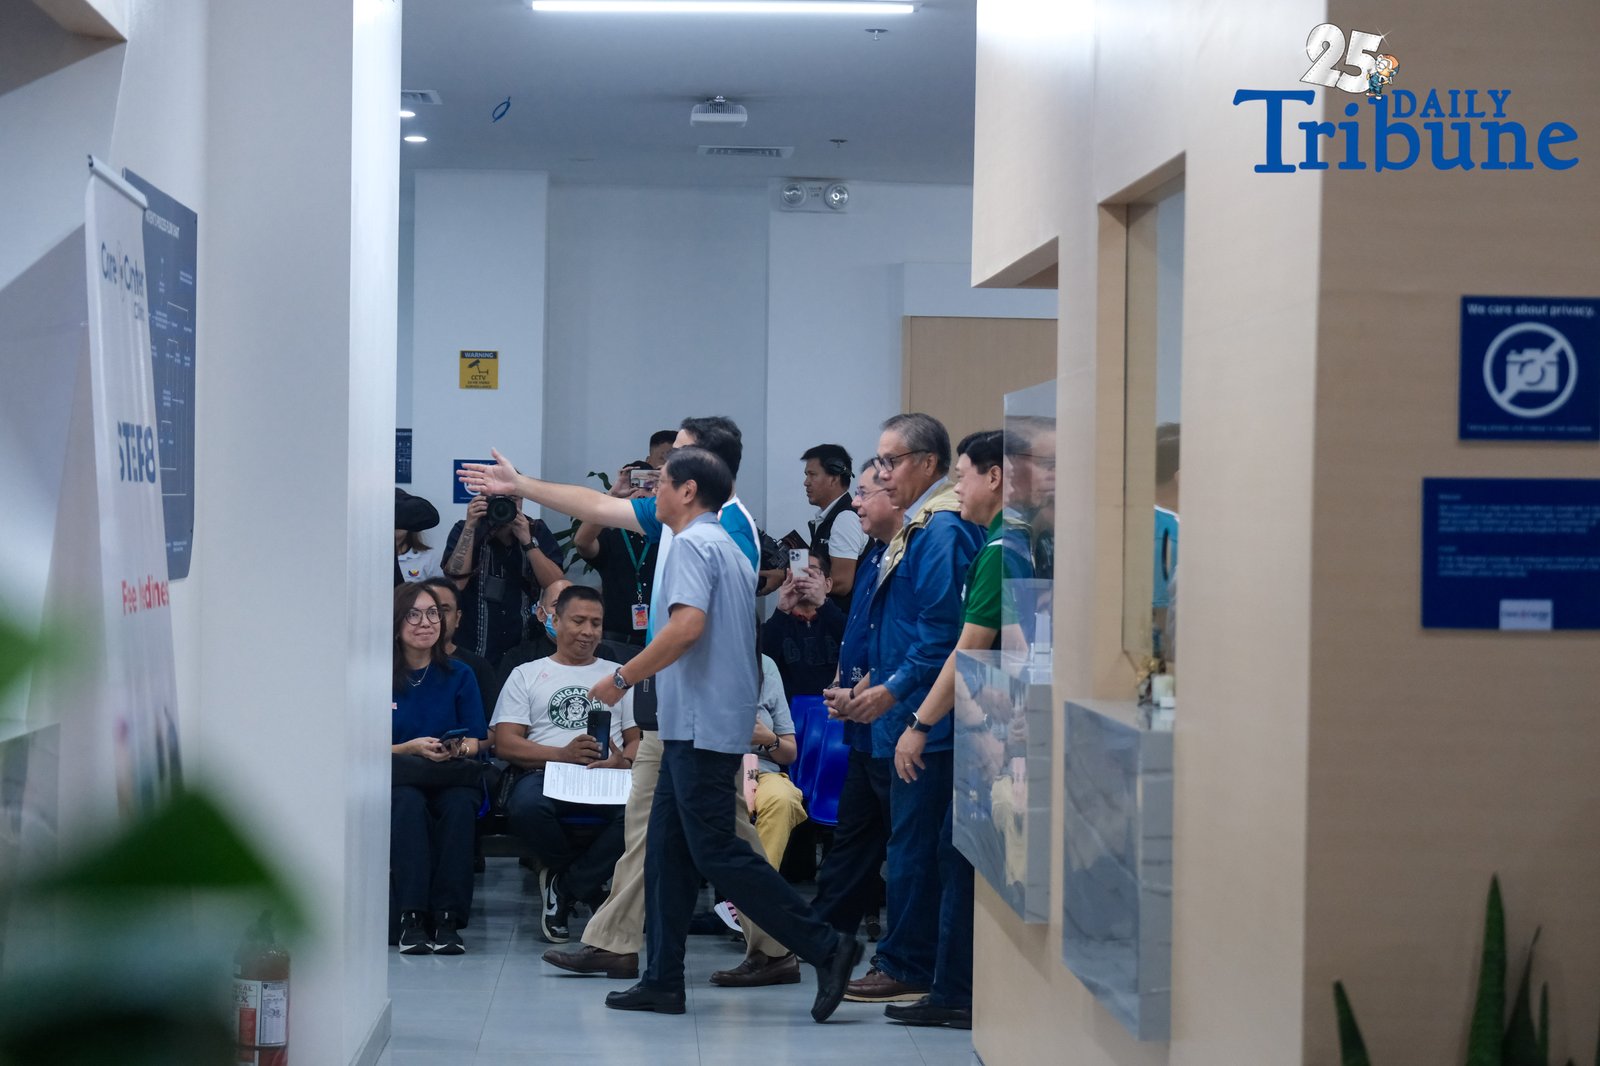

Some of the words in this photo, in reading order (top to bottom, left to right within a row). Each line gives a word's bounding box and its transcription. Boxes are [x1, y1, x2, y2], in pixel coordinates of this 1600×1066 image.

[1466, 303, 1486, 316] We
[1487, 305, 1513, 317] care
[1514, 303, 1549, 317] about
[552, 688, 600, 709] SINGAPE
